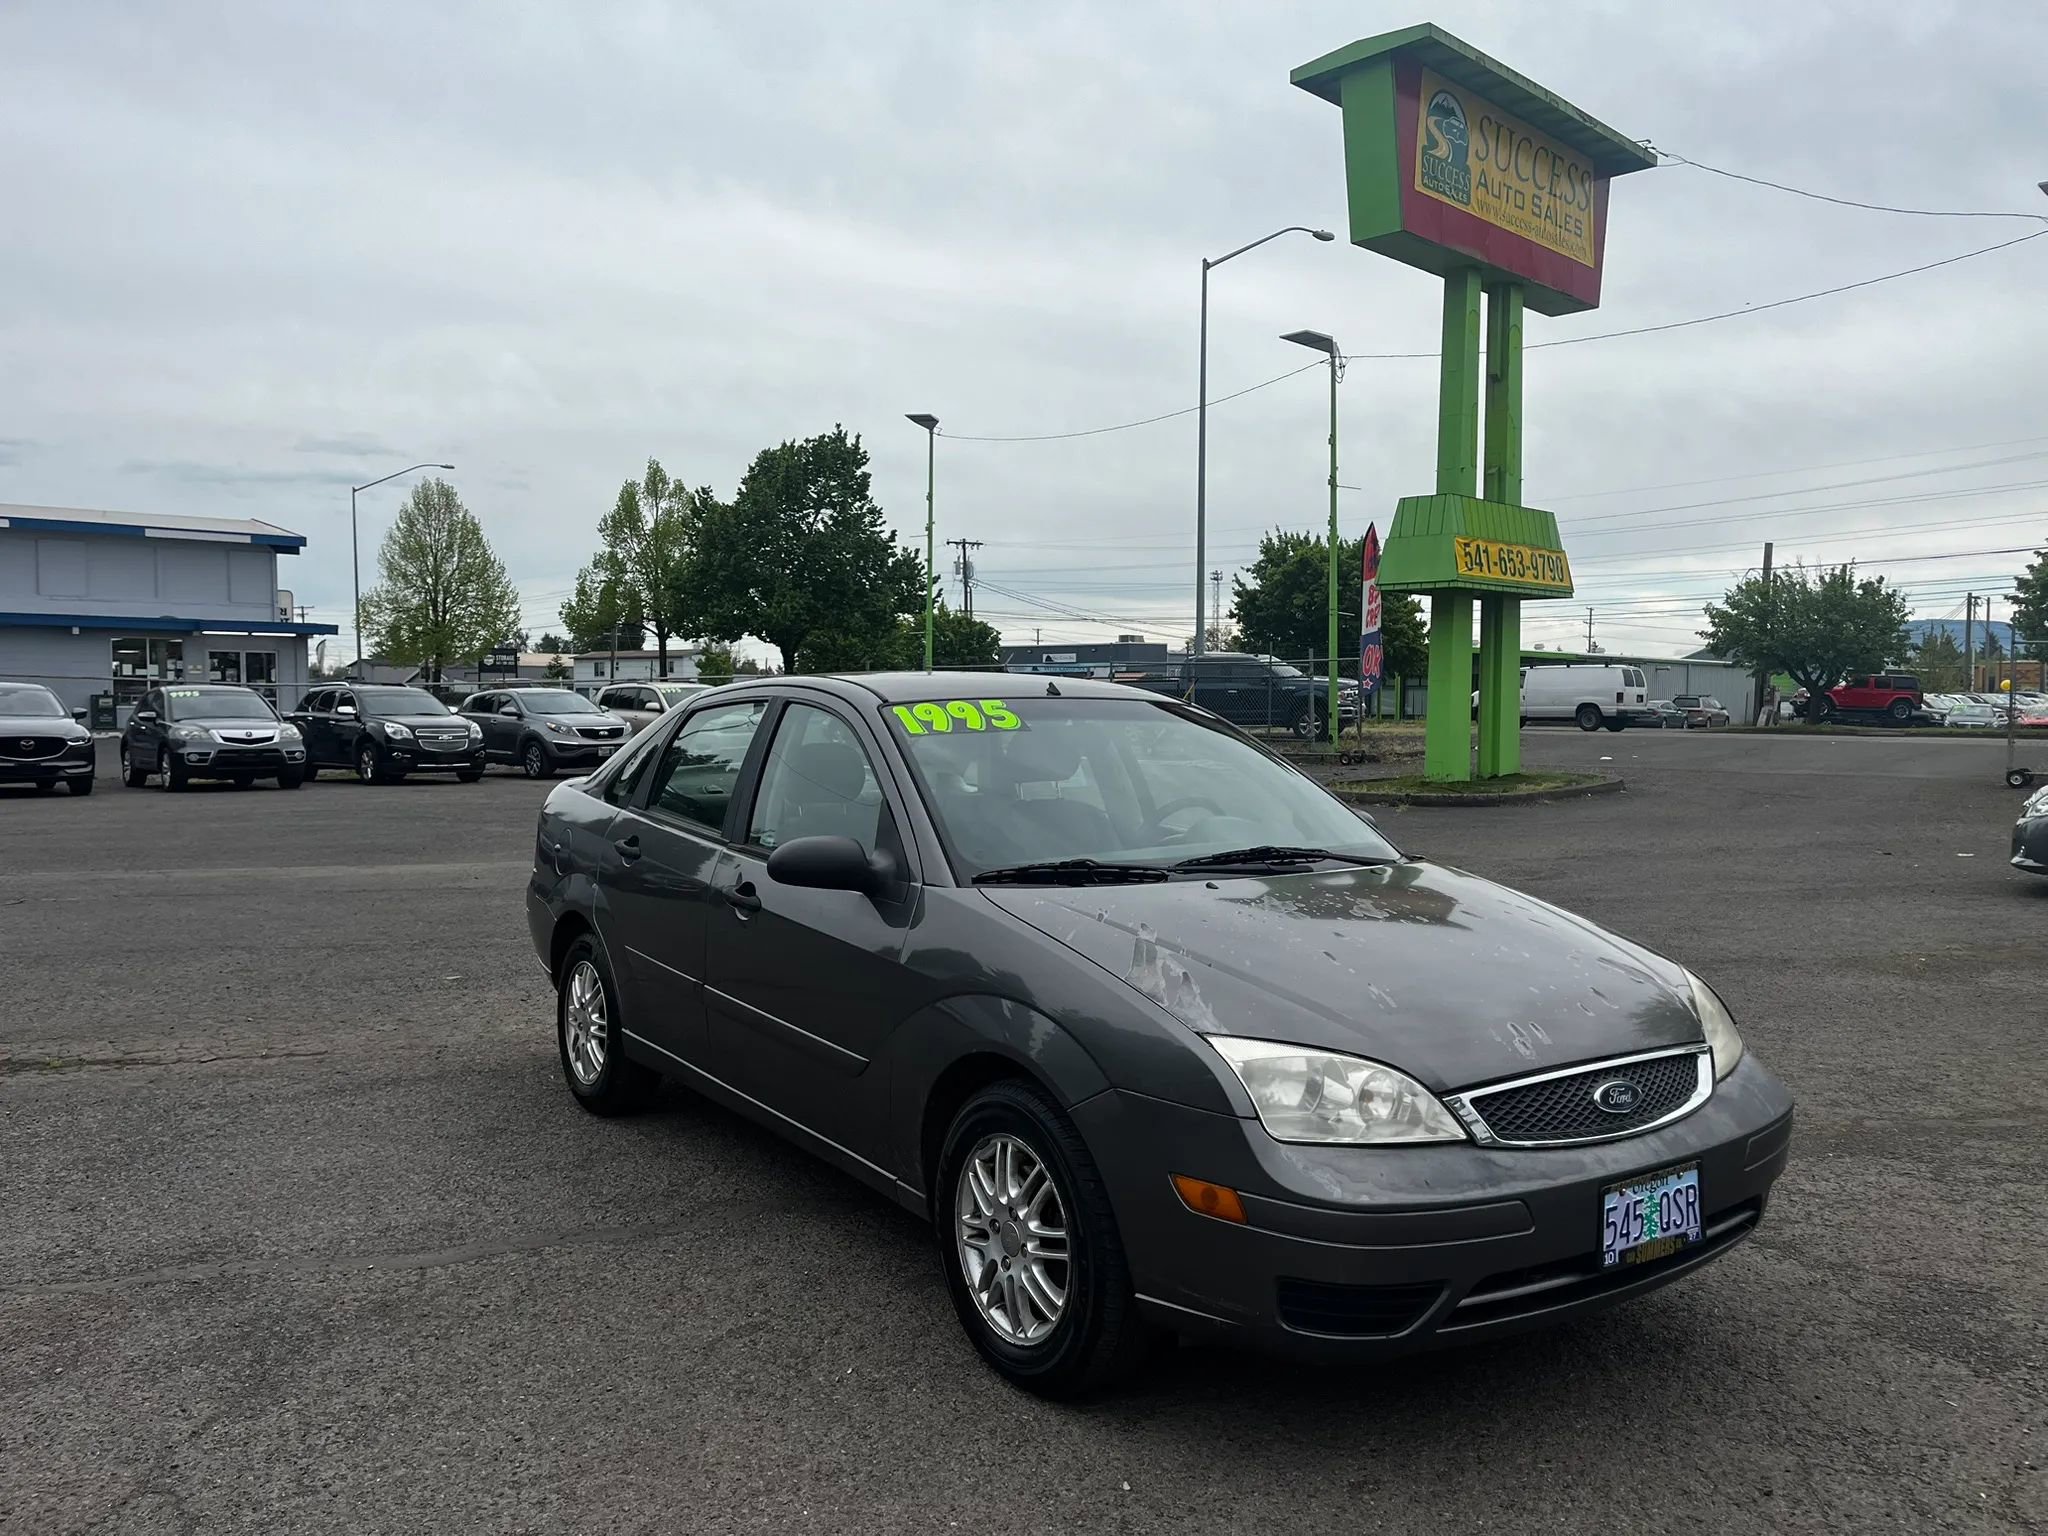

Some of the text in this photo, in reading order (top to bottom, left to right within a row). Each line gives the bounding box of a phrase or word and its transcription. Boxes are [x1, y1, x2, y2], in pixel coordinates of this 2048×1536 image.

[1422, 154, 1471, 192] SUCCESS
[1475, 115, 1592, 213] SUCCESS
[1423, 175, 1444, 191] AUTO
[1476, 167, 1583, 239] AUTO SALES
[1463, 542, 1565, 582] 541-653-9790
[892, 699, 1022, 735] 1995
[1608, 1087, 1633, 1104] Ford
[1632, 1174, 1670, 1195] Oregon
[1605, 1184, 1699, 1250] 545 QSR
[1604, 1251, 1615, 1265] 10
